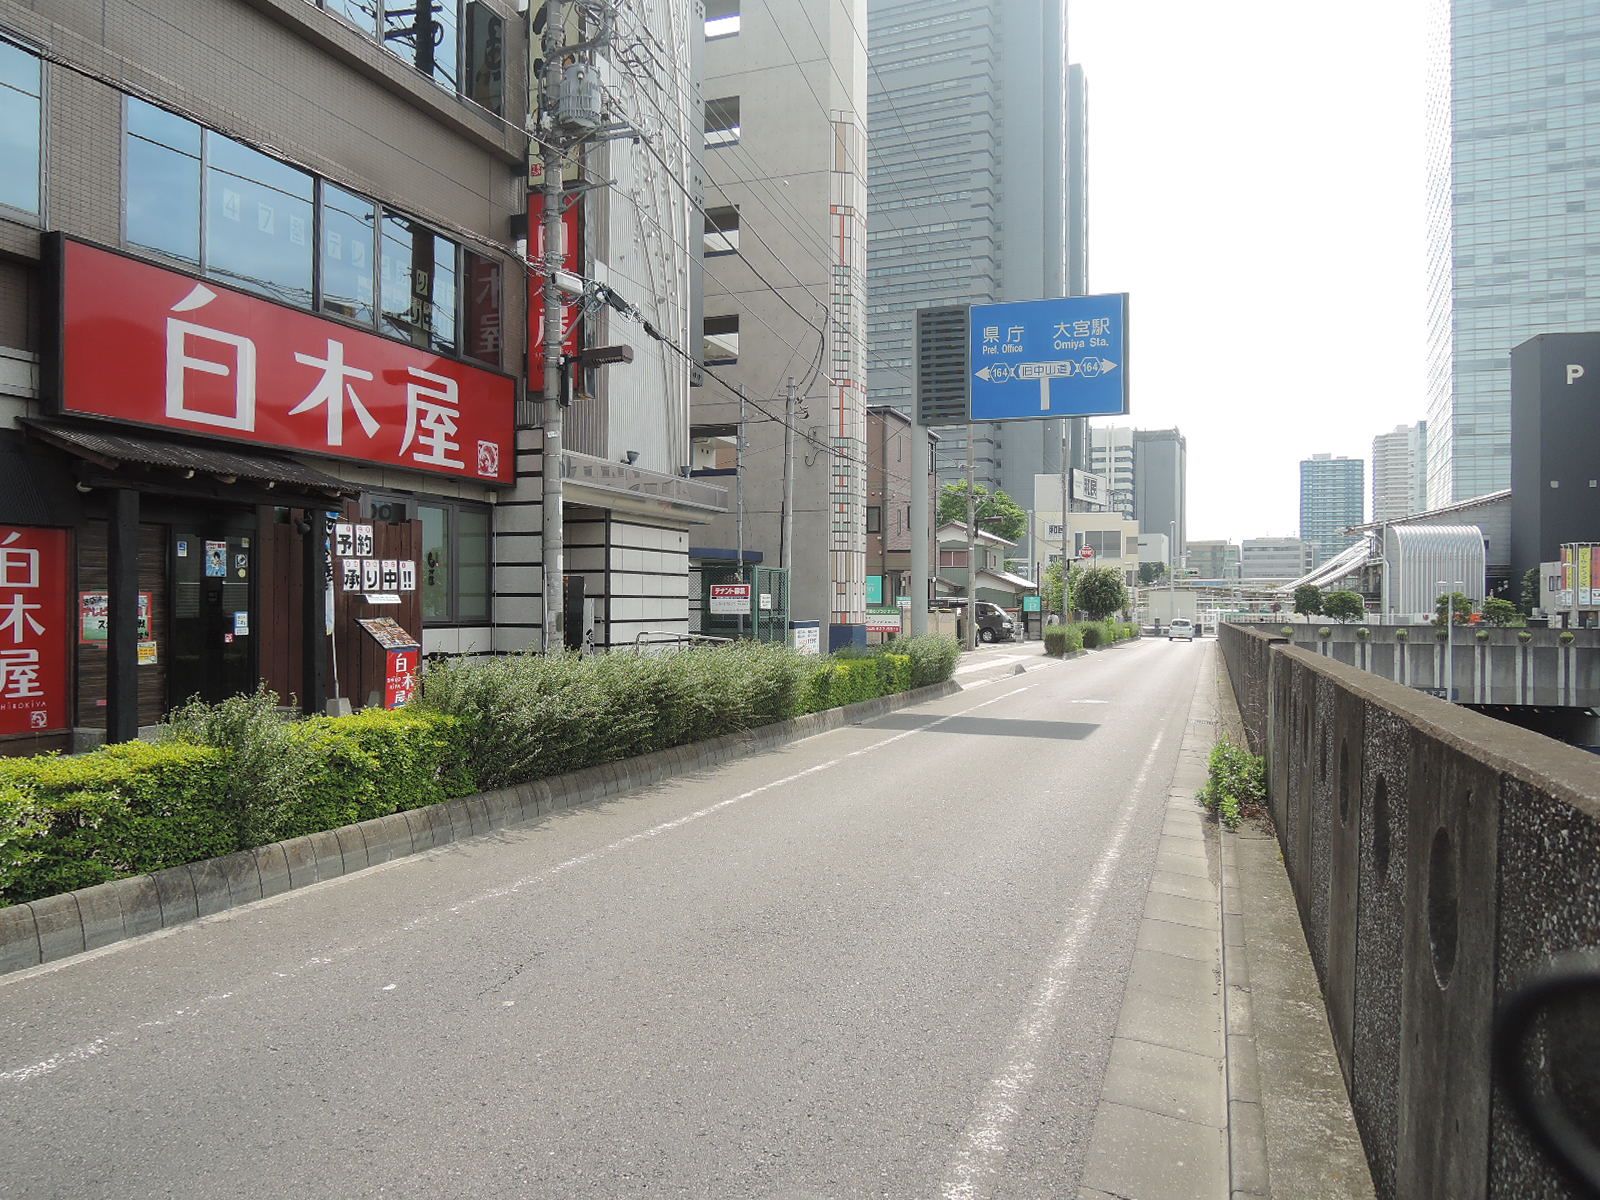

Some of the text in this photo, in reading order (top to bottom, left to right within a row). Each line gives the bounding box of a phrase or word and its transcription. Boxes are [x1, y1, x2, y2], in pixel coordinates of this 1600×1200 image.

[983, 325, 1024, 343] 県庁
[1053, 318, 1110, 339] 大宮駅
[982, 344, 1023, 355] Pref. Office
[1054, 337, 1109, 350] Omiya Sta.
[165, 283, 465, 469] 白木屋
[993, 368, 1009, 377] 164
[1021, 363, 1069, 377] 旧中山道
[1083, 362, 1098, 372] 164
[1566, 364, 1584, 385] P
[337, 534, 372, 555] 予約
[0, 531, 46, 699] 白木屋
[394, 652, 413, 704] 白木屋
